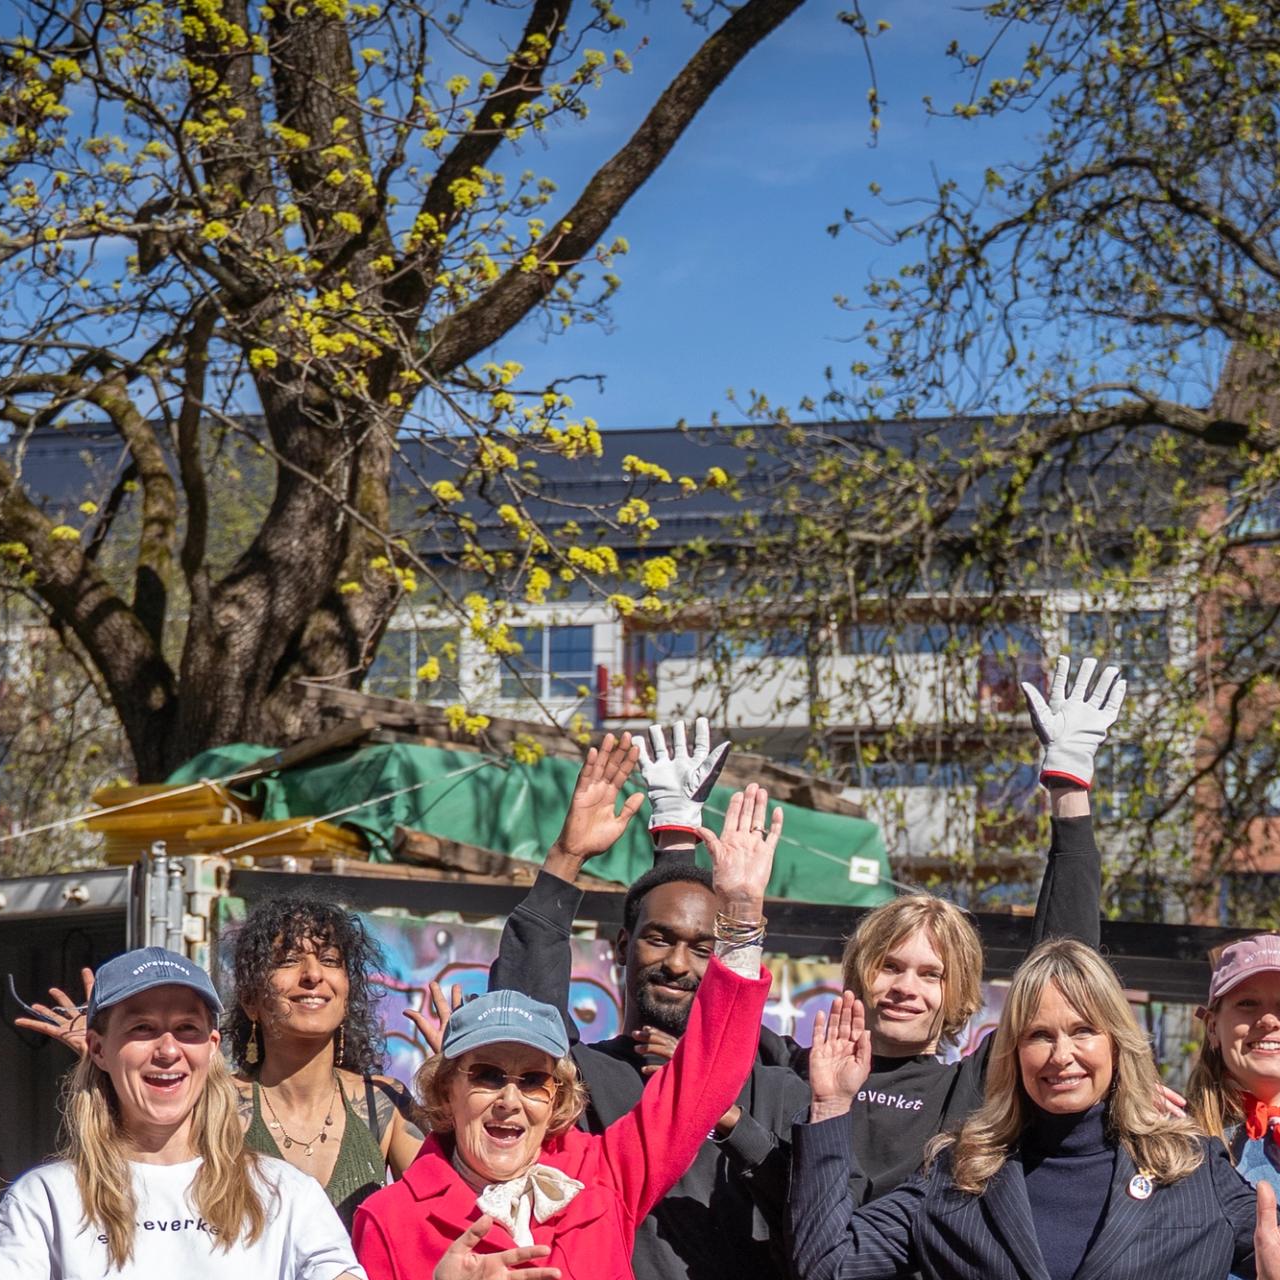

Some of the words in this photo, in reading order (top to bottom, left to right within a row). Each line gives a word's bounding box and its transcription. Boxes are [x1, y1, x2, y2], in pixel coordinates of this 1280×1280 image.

[132, 958, 190, 976] spireverket
[857, 1089, 924, 1110] everket
[97, 1217, 221, 1245] severke
